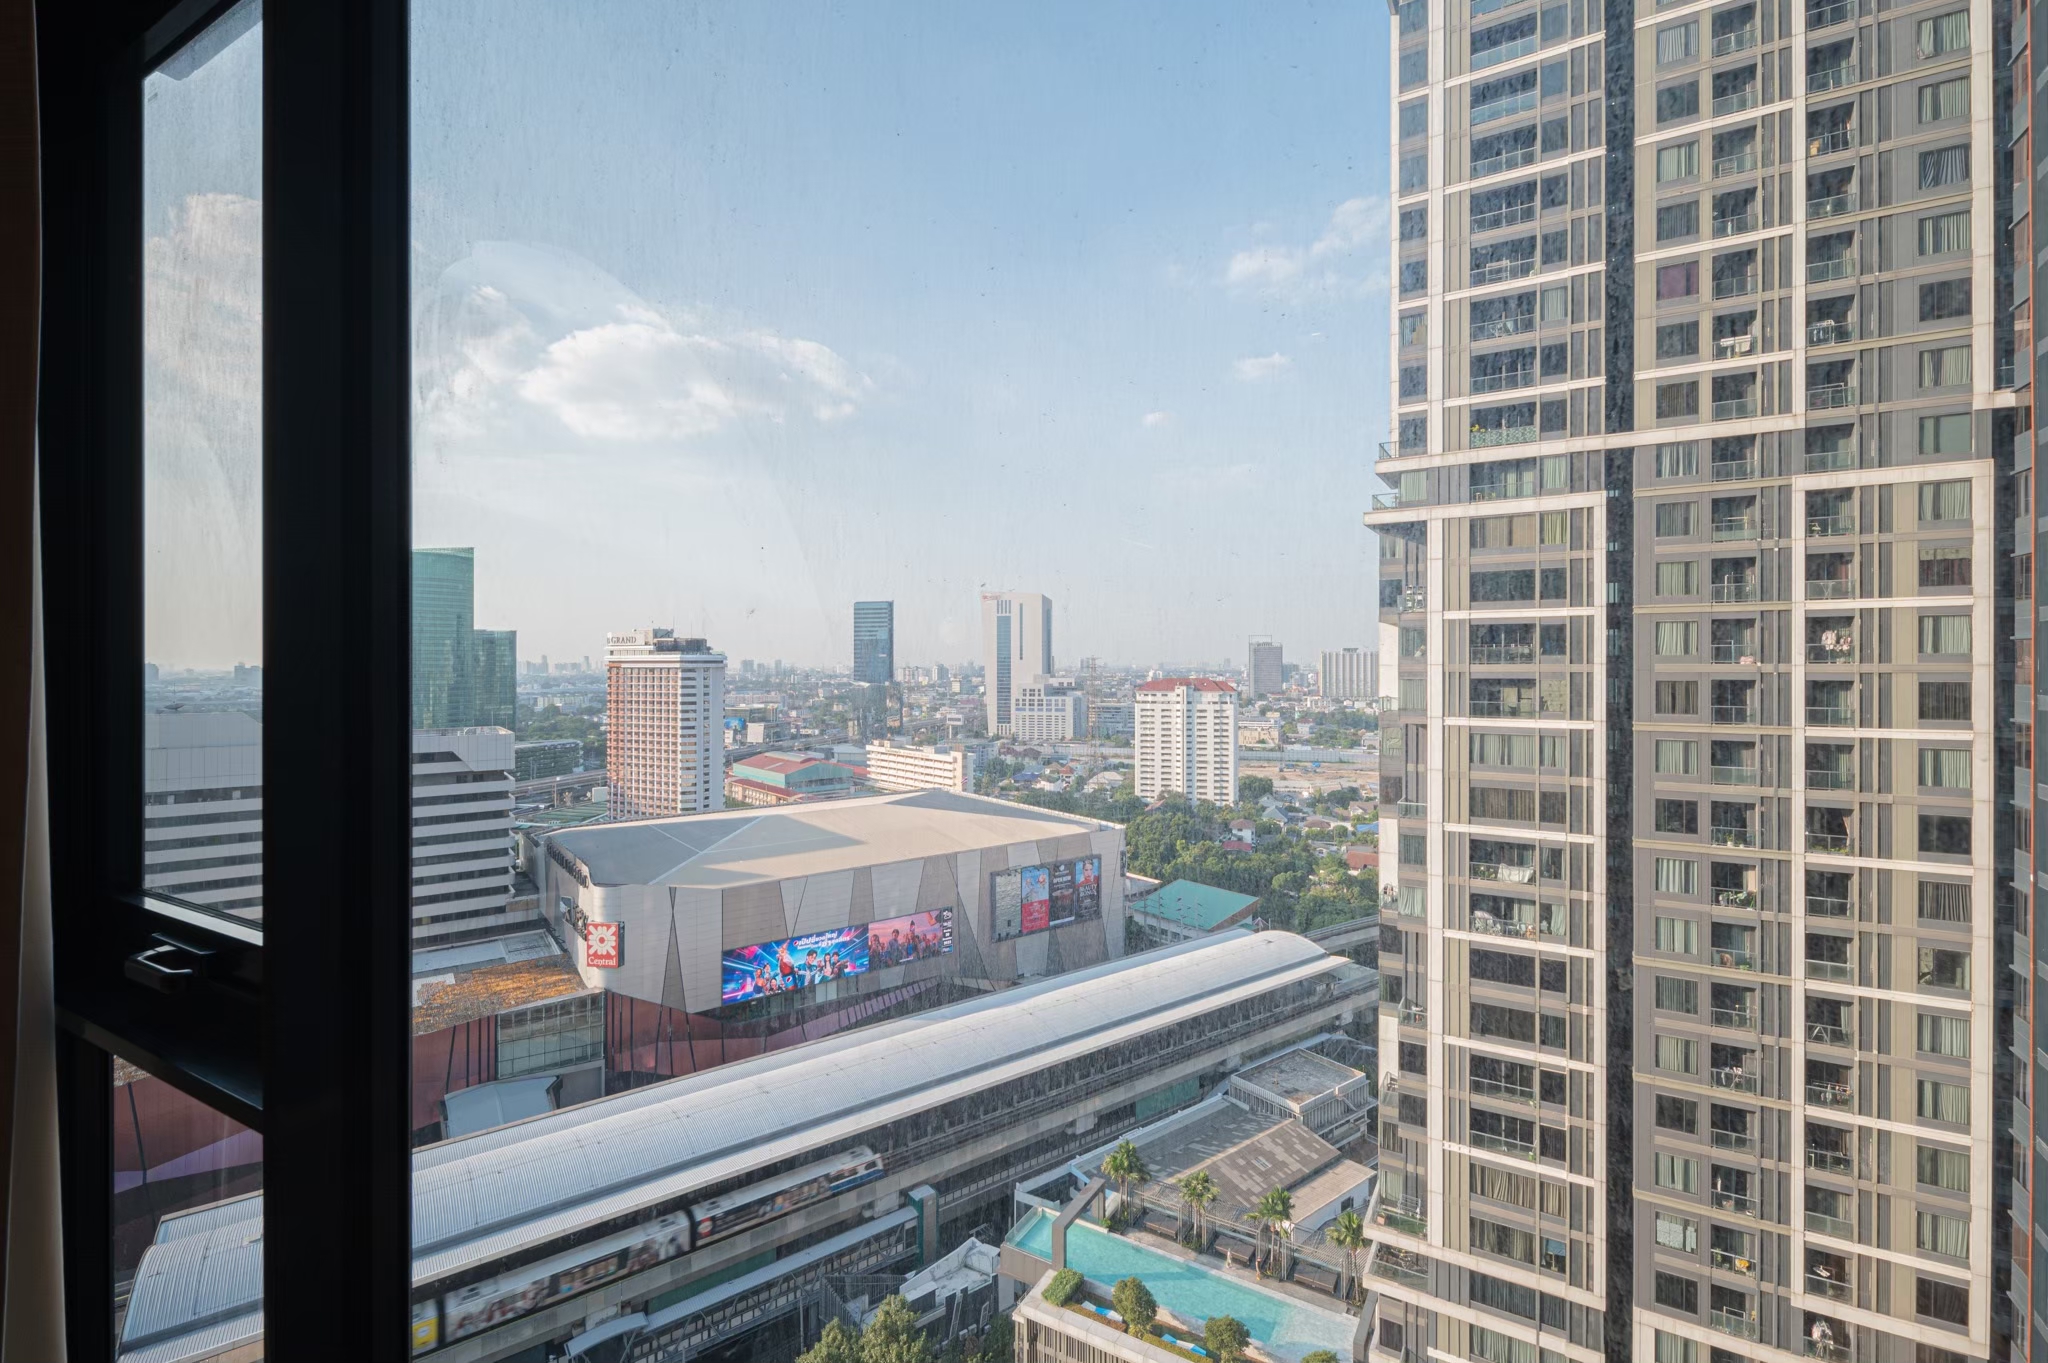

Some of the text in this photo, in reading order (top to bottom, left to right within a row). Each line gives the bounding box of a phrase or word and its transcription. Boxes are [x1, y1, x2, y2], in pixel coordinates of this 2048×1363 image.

[611, 636, 637, 645] GRAND
[1079, 884, 1098, 892] BEAUTY
[588, 956, 617, 967] Central
